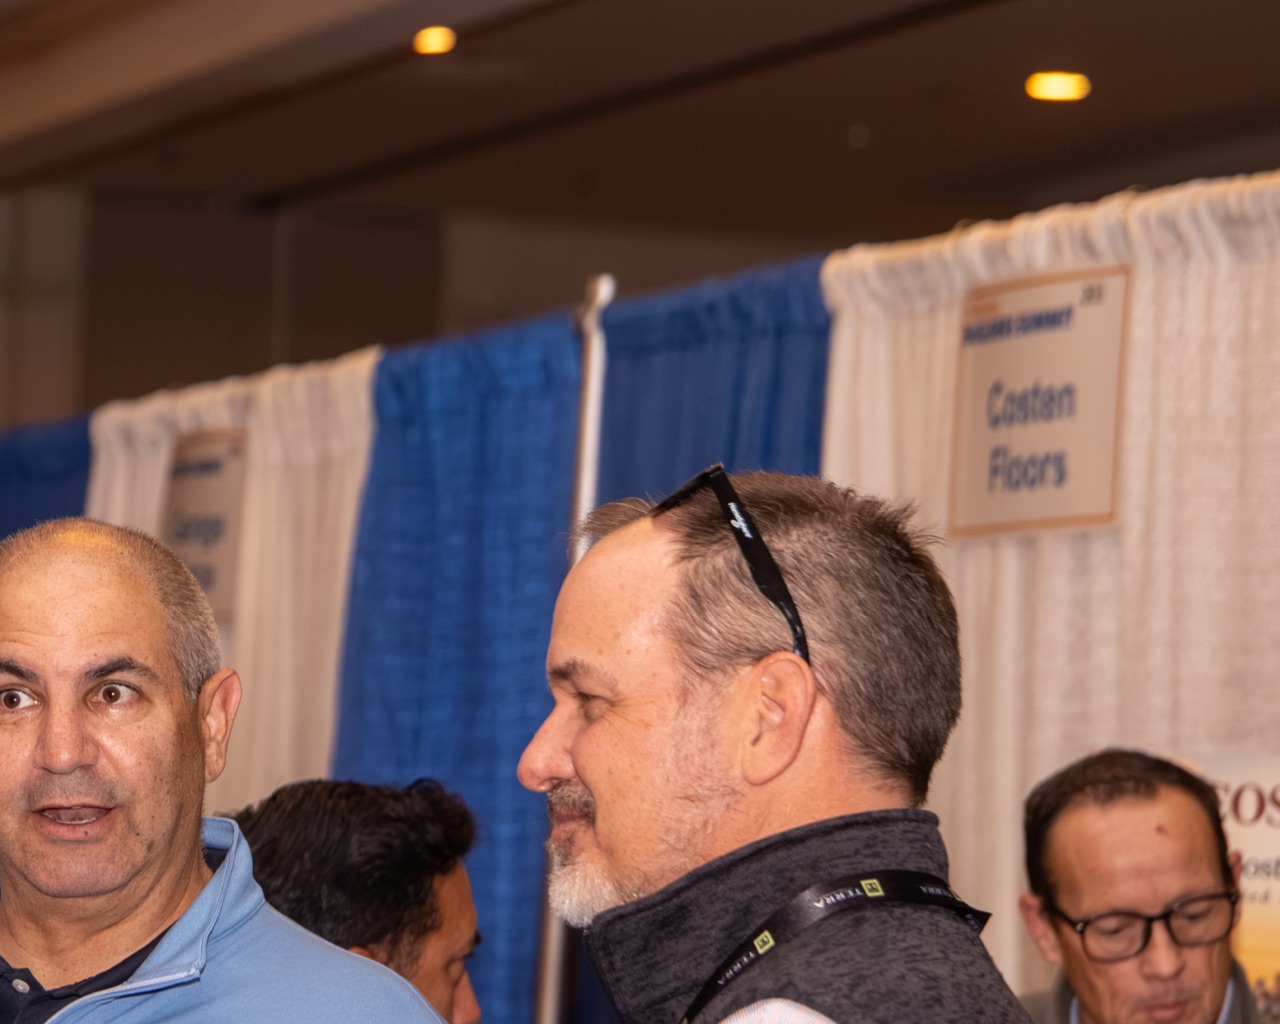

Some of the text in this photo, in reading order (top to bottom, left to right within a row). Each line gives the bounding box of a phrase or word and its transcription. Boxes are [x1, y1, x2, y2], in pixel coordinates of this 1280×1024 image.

[987, 445, 1067, 494] Floors
[813, 887, 864, 909] TERRA
[716, 951, 756, 985] TERRA
